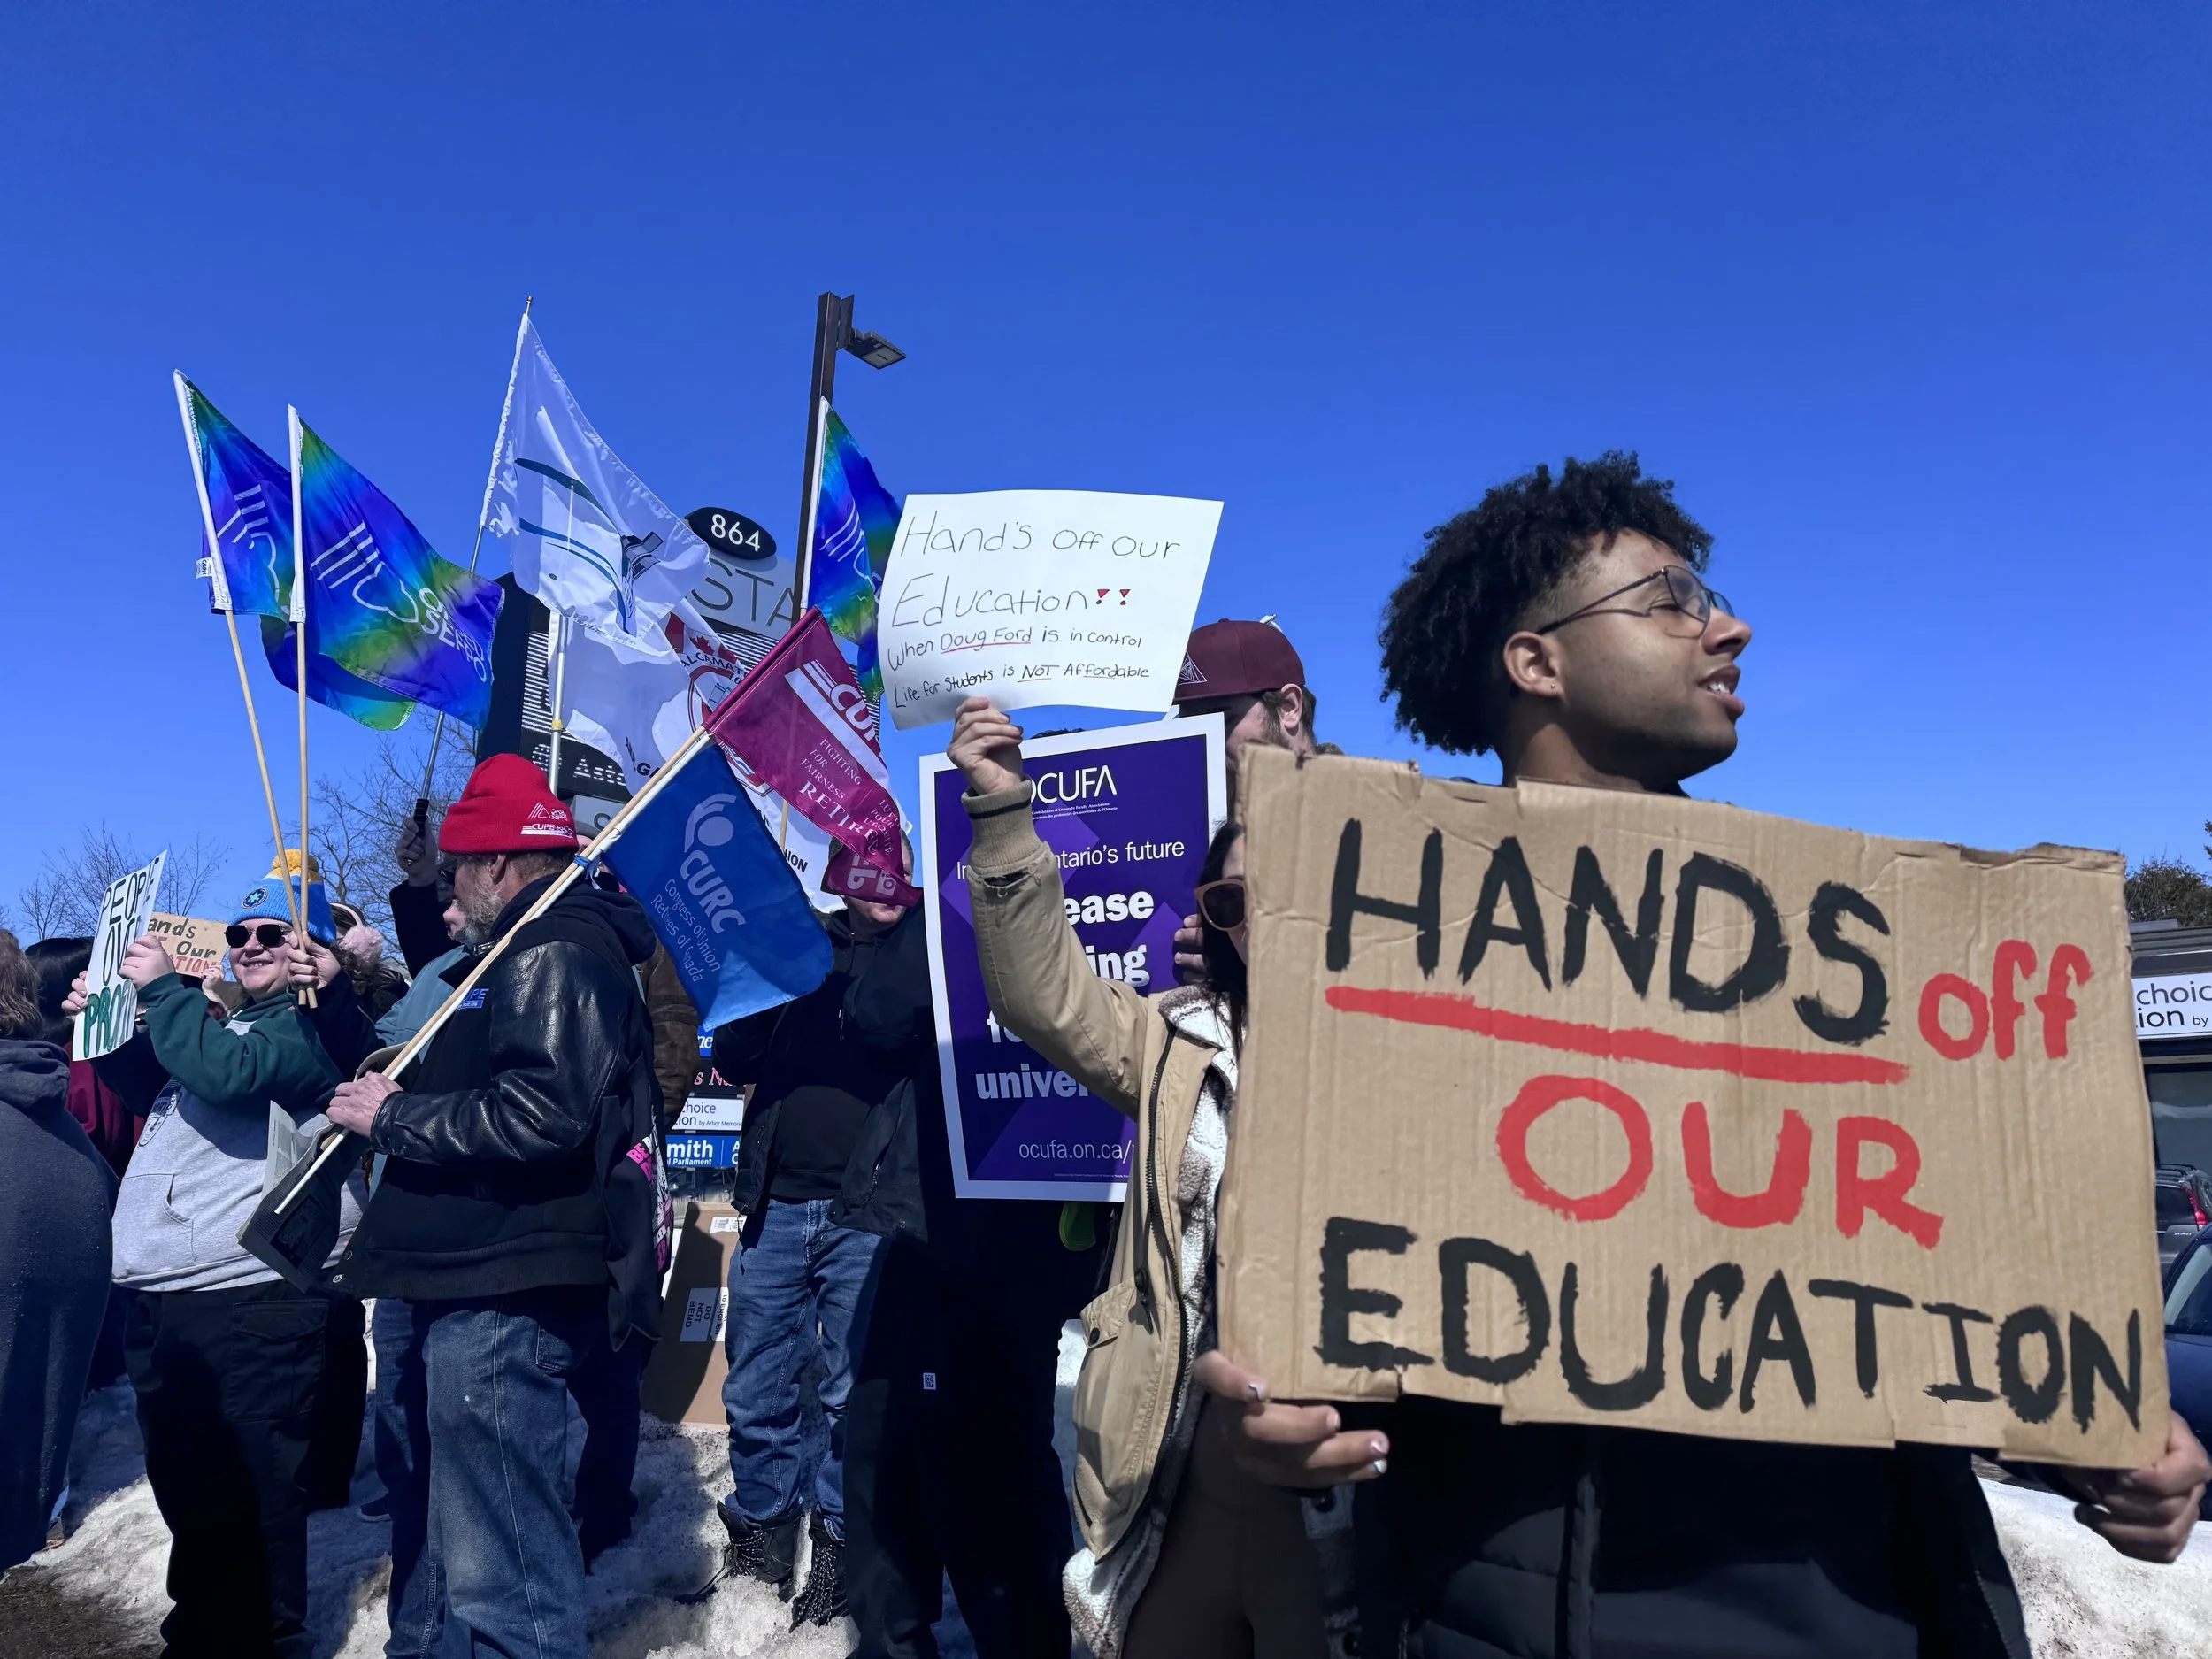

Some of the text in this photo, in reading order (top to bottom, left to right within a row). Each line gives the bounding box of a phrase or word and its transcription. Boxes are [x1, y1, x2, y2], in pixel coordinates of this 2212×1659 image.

[710, 513, 761, 552] 864
[900, 510, 1032, 557] Hand's
[887, 640, 933, 671] When
[941, 630, 987, 652] Doug
[994, 626, 1032, 642] Ford
[1070, 628, 1083, 641] in
[894, 685, 921, 708] Life
[923, 680, 941, 697] for
[1002, 664, 1015, 678] is
[1021, 664, 1060, 680] NOT
[809, 748, 828, 769] FOR
[818, 738, 864, 786] FIGHTING
[800, 757, 846, 800] FAIRNESS
[870, 808, 895, 828] POUR
[1055, 844, 1119, 869] ntario's
[1125, 841, 1185, 862] future
[96, 856, 161, 940] PEOPLE
[680, 849, 747, 934] CURC
[1064, 890, 1155, 926] ease
[664, 878, 695, 926] Congress
[697, 932, 721, 972] Union
[1325, 817, 2095, 1060] HANDS off
[176, 941, 218, 959] Our
[677, 934, 691, 949] of
[465, 988, 489, 1000] PE
[2135, 1007, 2209, 1028] ion by
[674, 1116, 697, 1126] ion
[666, 1138, 714, 1158] mith
[1018, 1139, 1135, 1164] ocufa.on.ca/
[1494, 1072, 1945, 1252] OUR
[685, 1300, 697, 1328] BEND
[695, 1302, 704, 1323] NOT
[703, 1305, 712, 1320] DO
[715, 1303, 726, 1335] ENGLISH
[1313, 1213, 2144, 1435] EDUCATION
